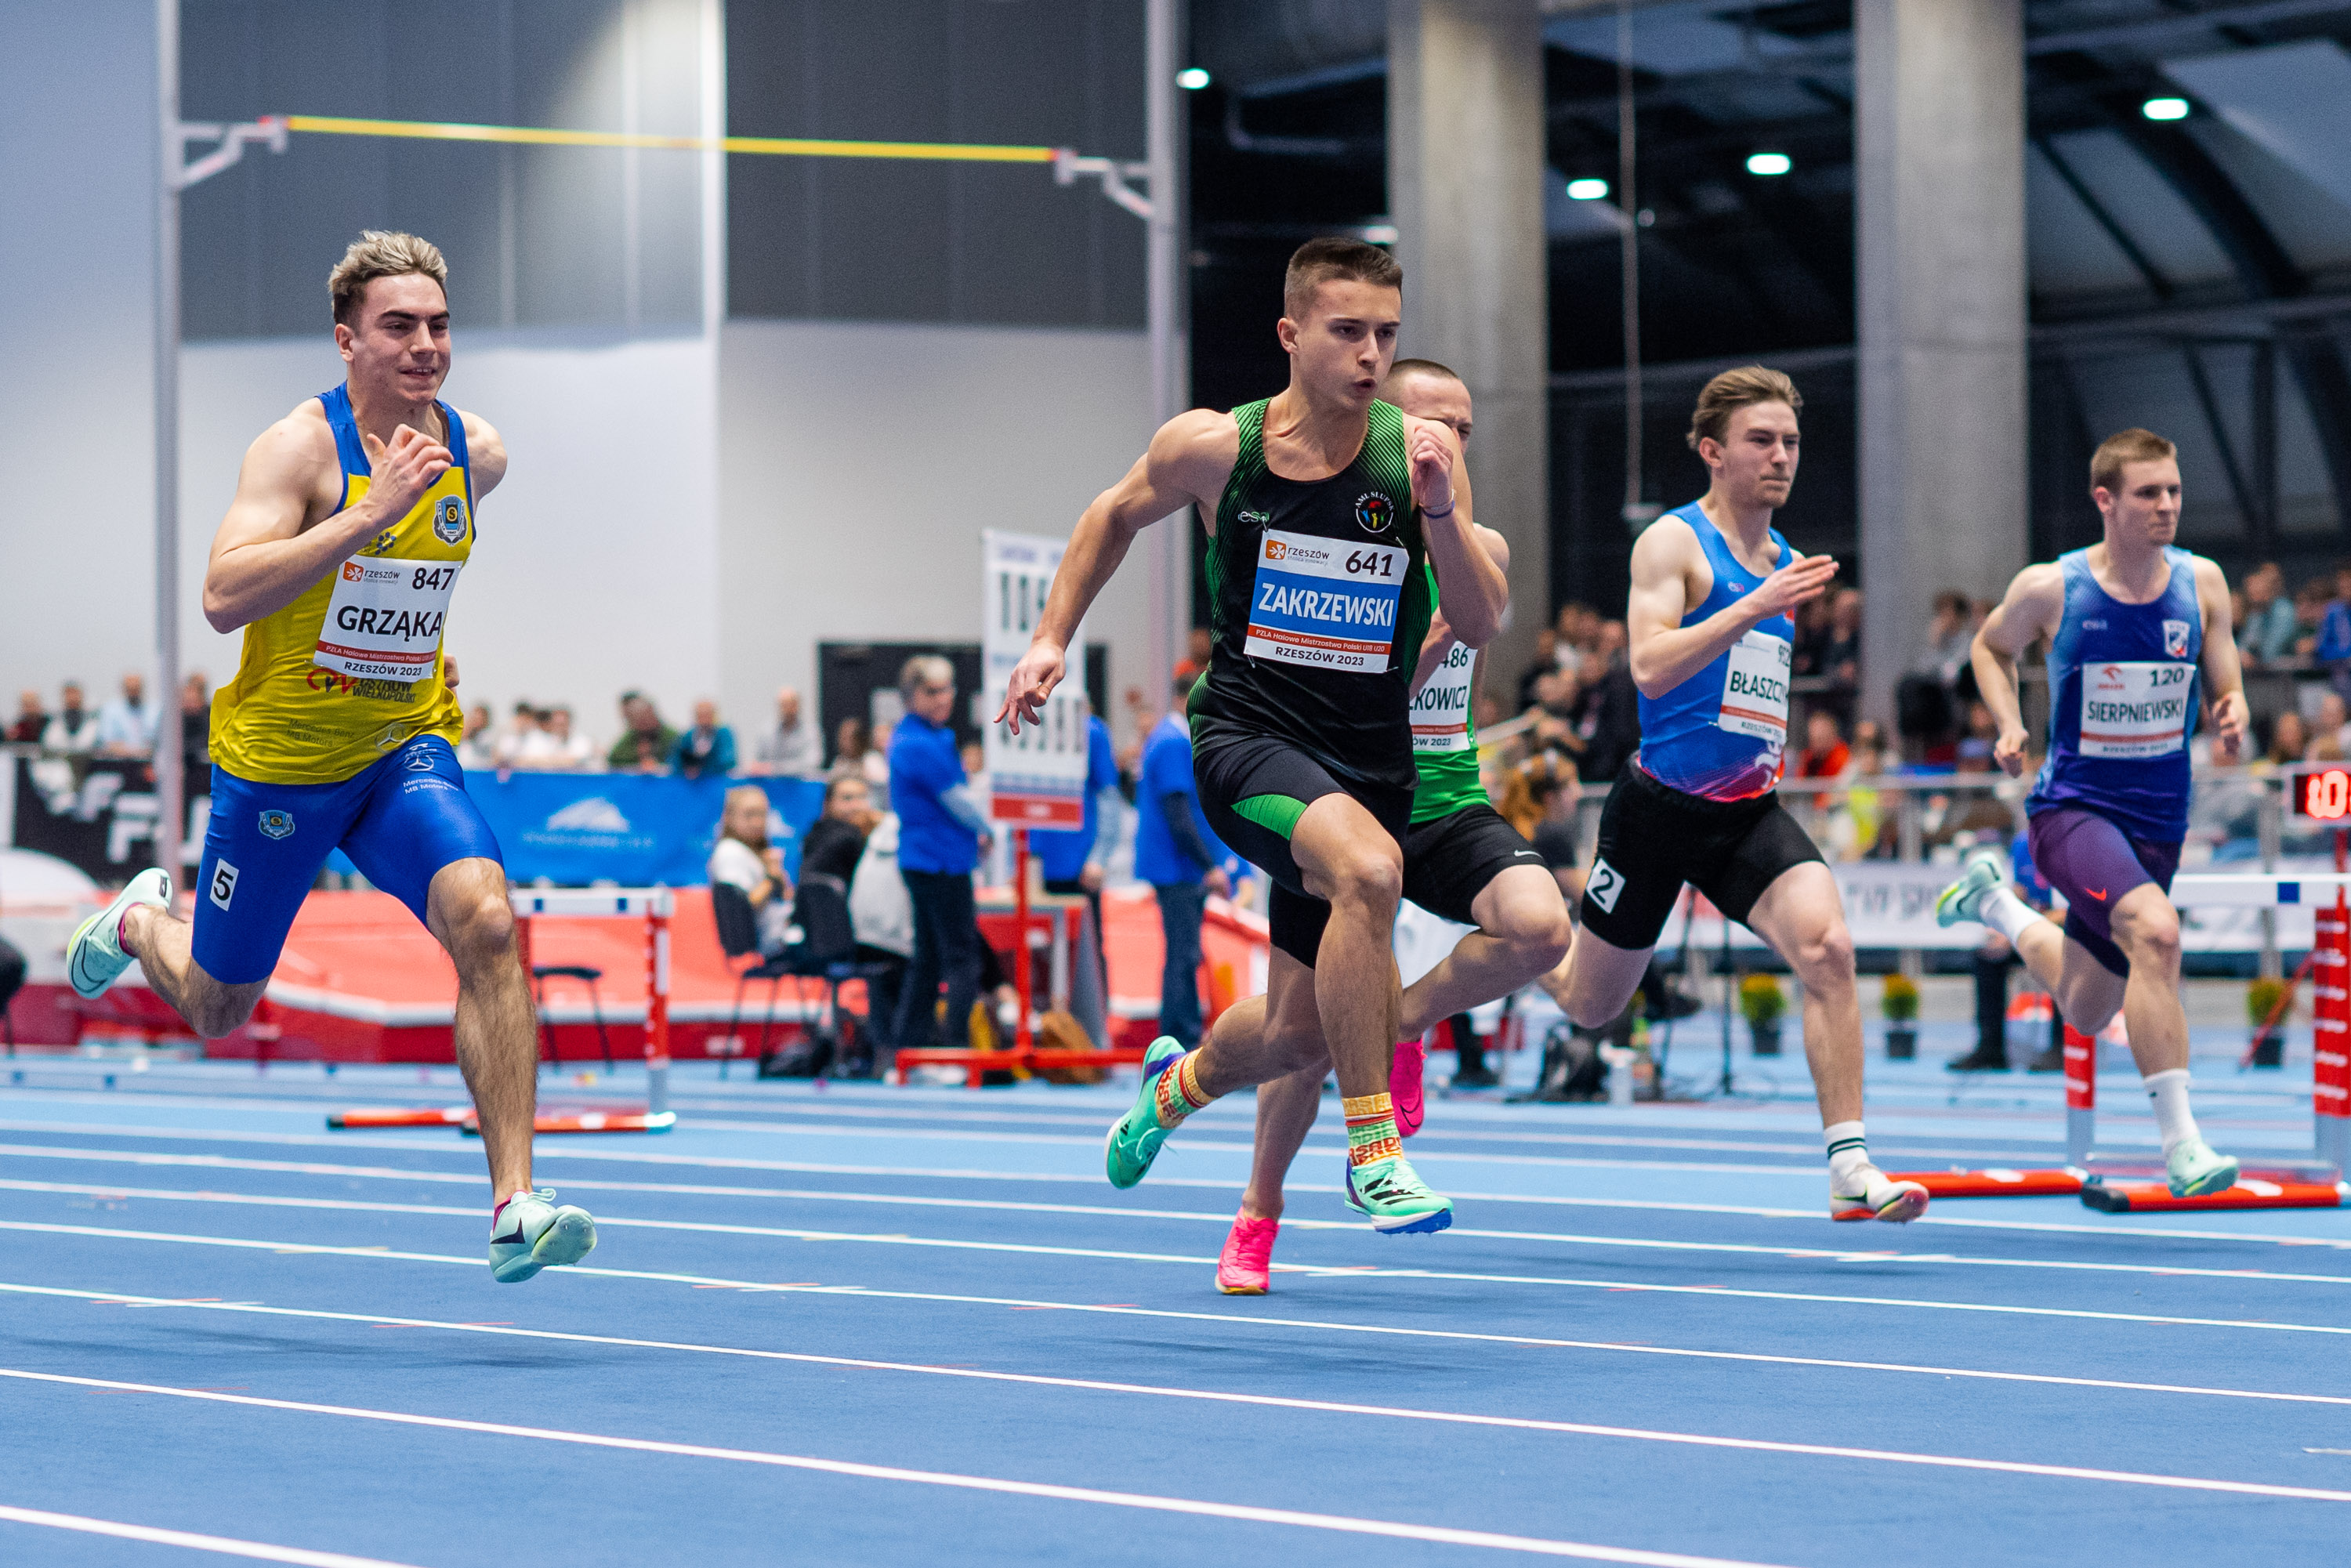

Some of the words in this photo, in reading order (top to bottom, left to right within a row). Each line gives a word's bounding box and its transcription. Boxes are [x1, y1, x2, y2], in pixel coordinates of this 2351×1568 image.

[1288, 547, 1330, 559] rzeszów
[1346, 550, 1393, 577] 641
[364, 570, 400, 579] rzeszów
[411, 567, 455, 591] 847
[1258, 582, 1394, 627] ZAKRZEWSKI
[336, 605, 443, 642] GRZĄKA
[1275, 646, 1335, 663] RZESZÓW
[1336, 654, 1364, 666] 2023
[1343, 643, 1362, 651] Polski
[345, 661, 398, 675] RZESZÓW
[400, 667, 422, 676] 2023
[2150, 668, 2185, 687] 120
[1409, 685, 1467, 711] KOWICZ
[2088, 697, 2183, 722] SIERPNIEWSKI
[214, 868, 234, 901] 5
[1592, 868, 1614, 904] 2
